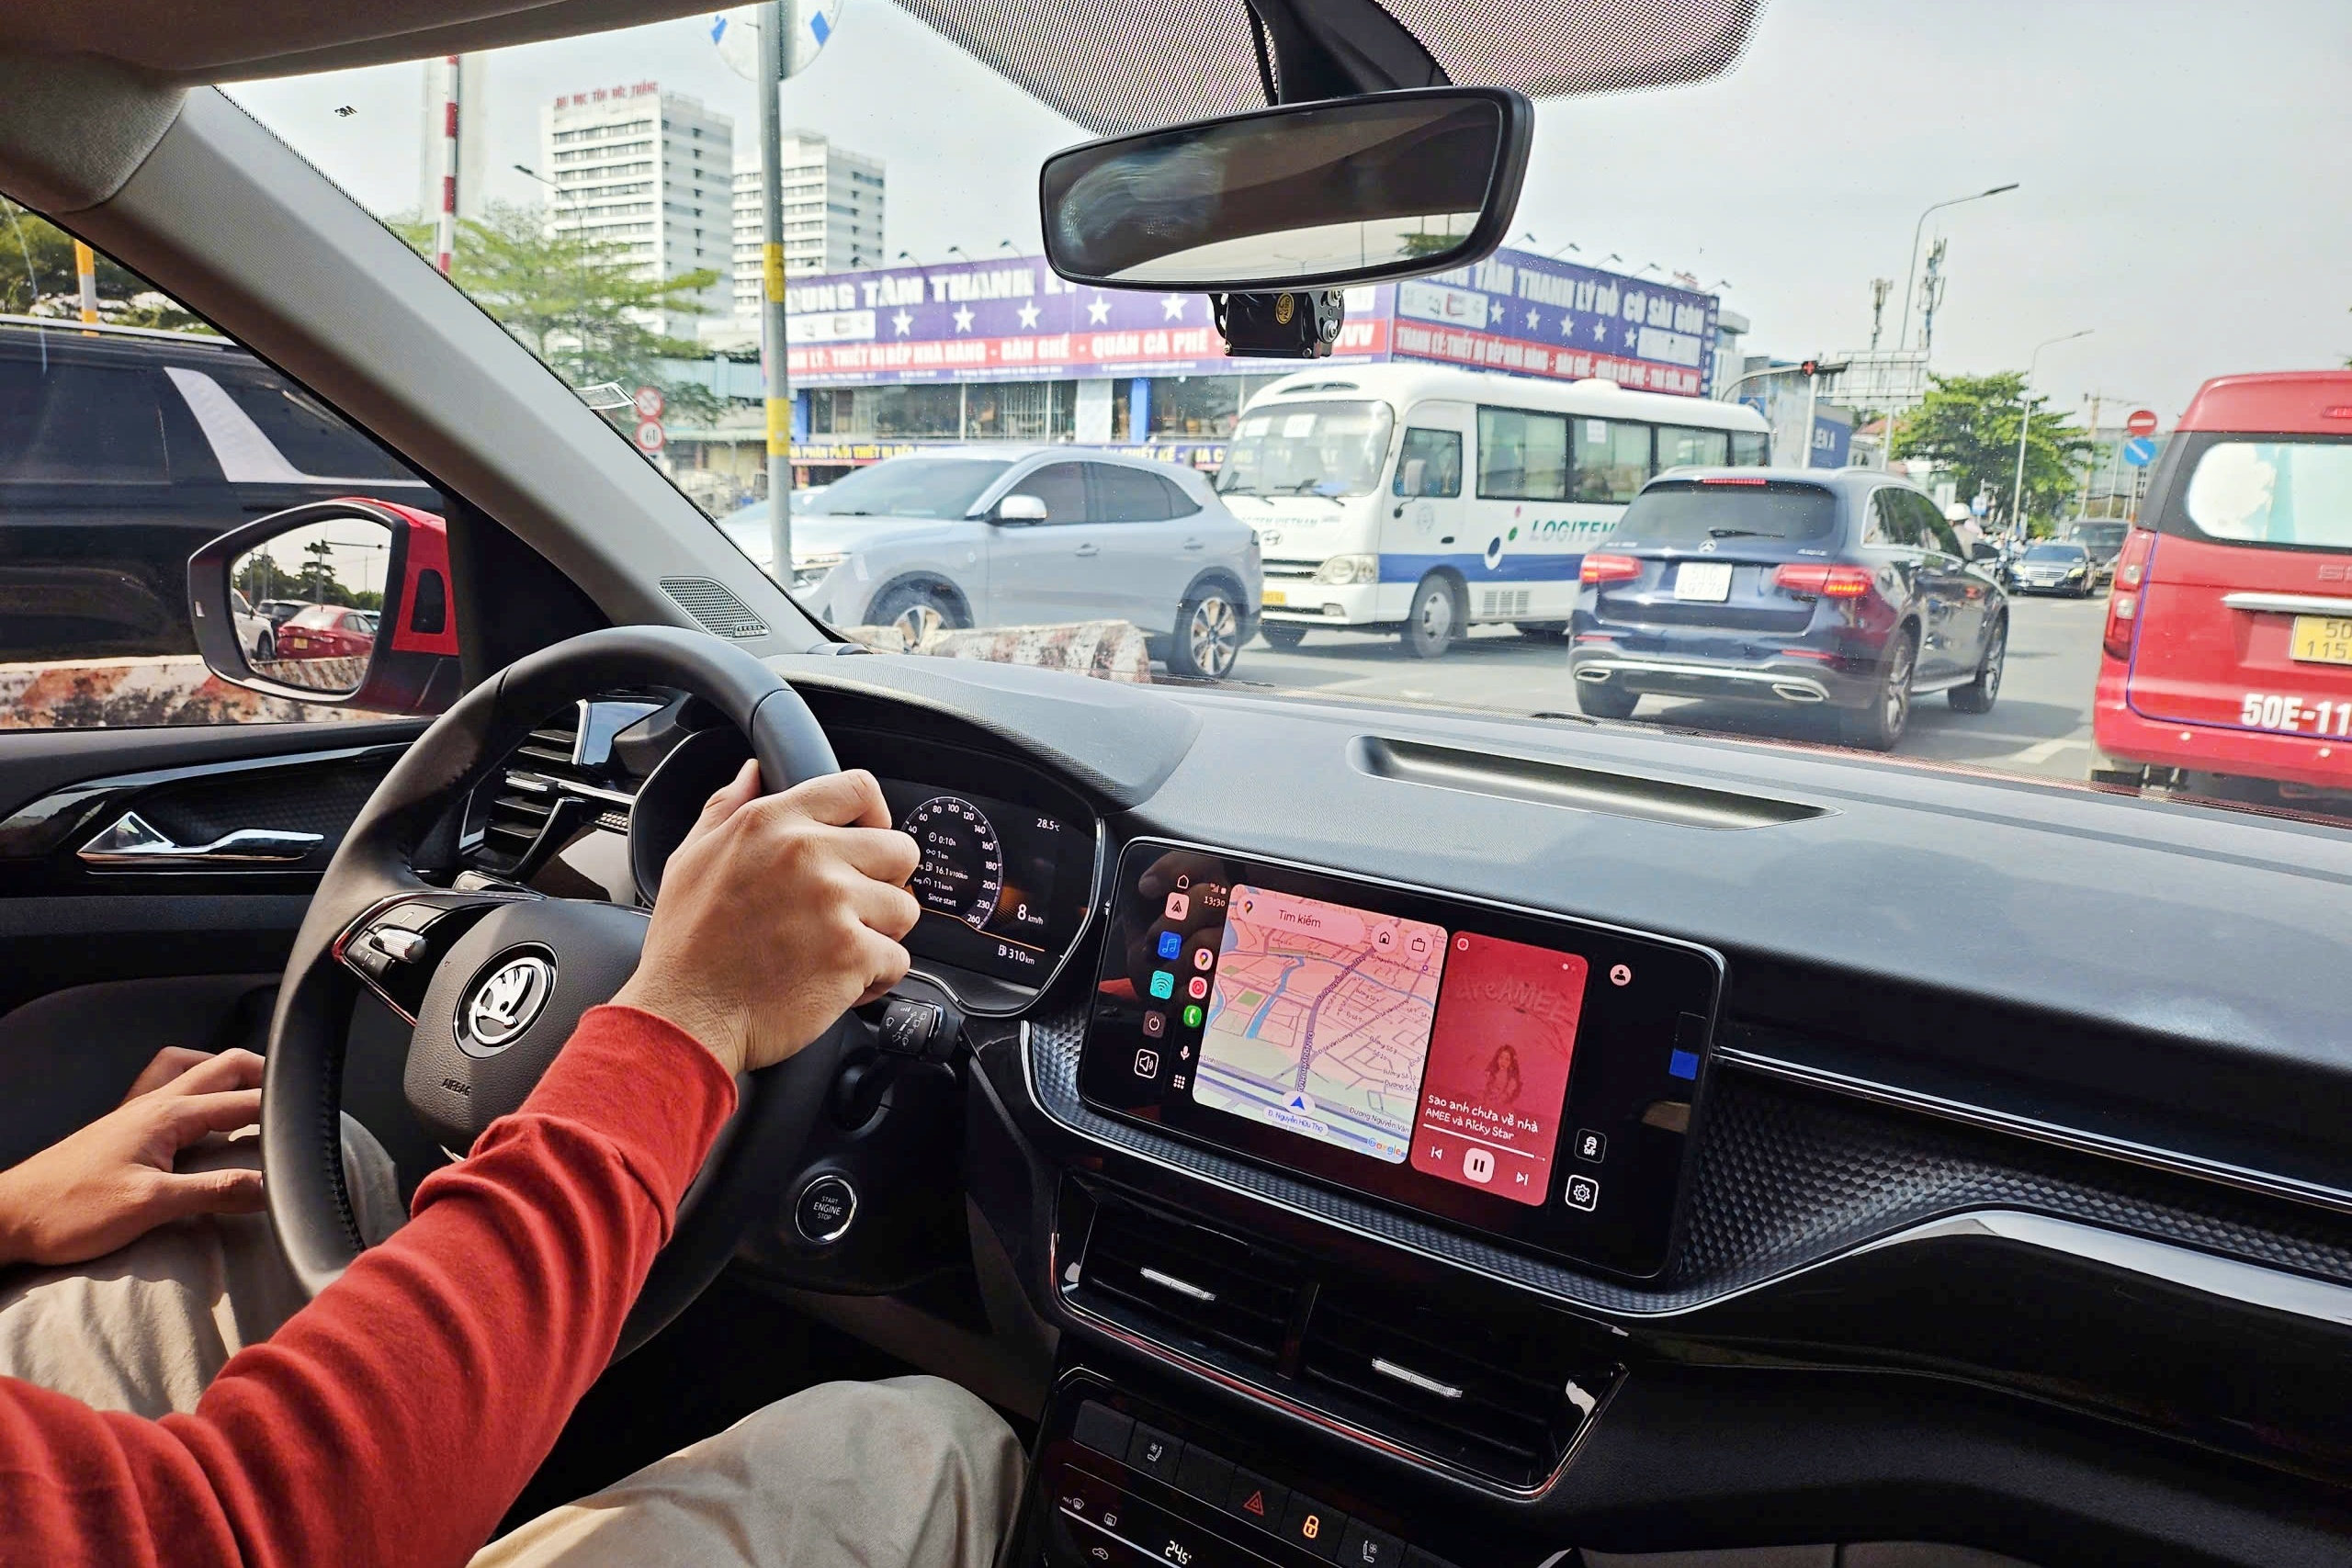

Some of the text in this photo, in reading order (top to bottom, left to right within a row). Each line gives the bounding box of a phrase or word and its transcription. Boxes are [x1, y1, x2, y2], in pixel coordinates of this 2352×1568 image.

[786, 283, 856, 313] RUNG
[861, 275, 924, 308] TÂM
[930, 268, 1035, 302] THANH
[1001, 338, 1035, 361] BÀN
[1036, 332, 1071, 359] GHẾ
[1091, 332, 1139, 357] QUÁN
[1143, 330, 1170, 355] CÀ
[1173, 327, 1209, 355] PHÊ
[933, 805, 943, 814] 80
[947, 804, 960, 814] 100
[919, 813, 928, 822] 60
[963, 811, 975, 821] 120
[908, 826, 918, 834] 40
[974, 825, 987, 835] 140
[981, 840, 994, 851] 160
[985, 861, 998, 872] 180
[982, 880, 997, 891] 200
[928, 893, 956, 908] Since start
[977, 899, 991, 909] 230
[1204, 896, 1226, 908] 13:30
[967, 913, 981, 925] 260
[1017, 904, 1044, 925] 8 km/h
[1297, 914, 1321, 928] kiếm
[441, 1078, 471, 1096] AIRBAG
[1428, 1095, 1538, 1133] sao anh chưa về nhà
[1274, 1111, 1298, 1124] Nguyễn
[1298, 1118, 1311, 1127] Hữu
[1311, 1122, 1323, 1132] Thọ
[1425, 1108, 1514, 1140] AMEE và Ricky Star
[821, 1195, 839, 1204] START
[813, 1201, 842, 1216] ENGINE
[818, 1213, 832, 1221] STOP
[1062, 1496, 1072, 1505] MAX
